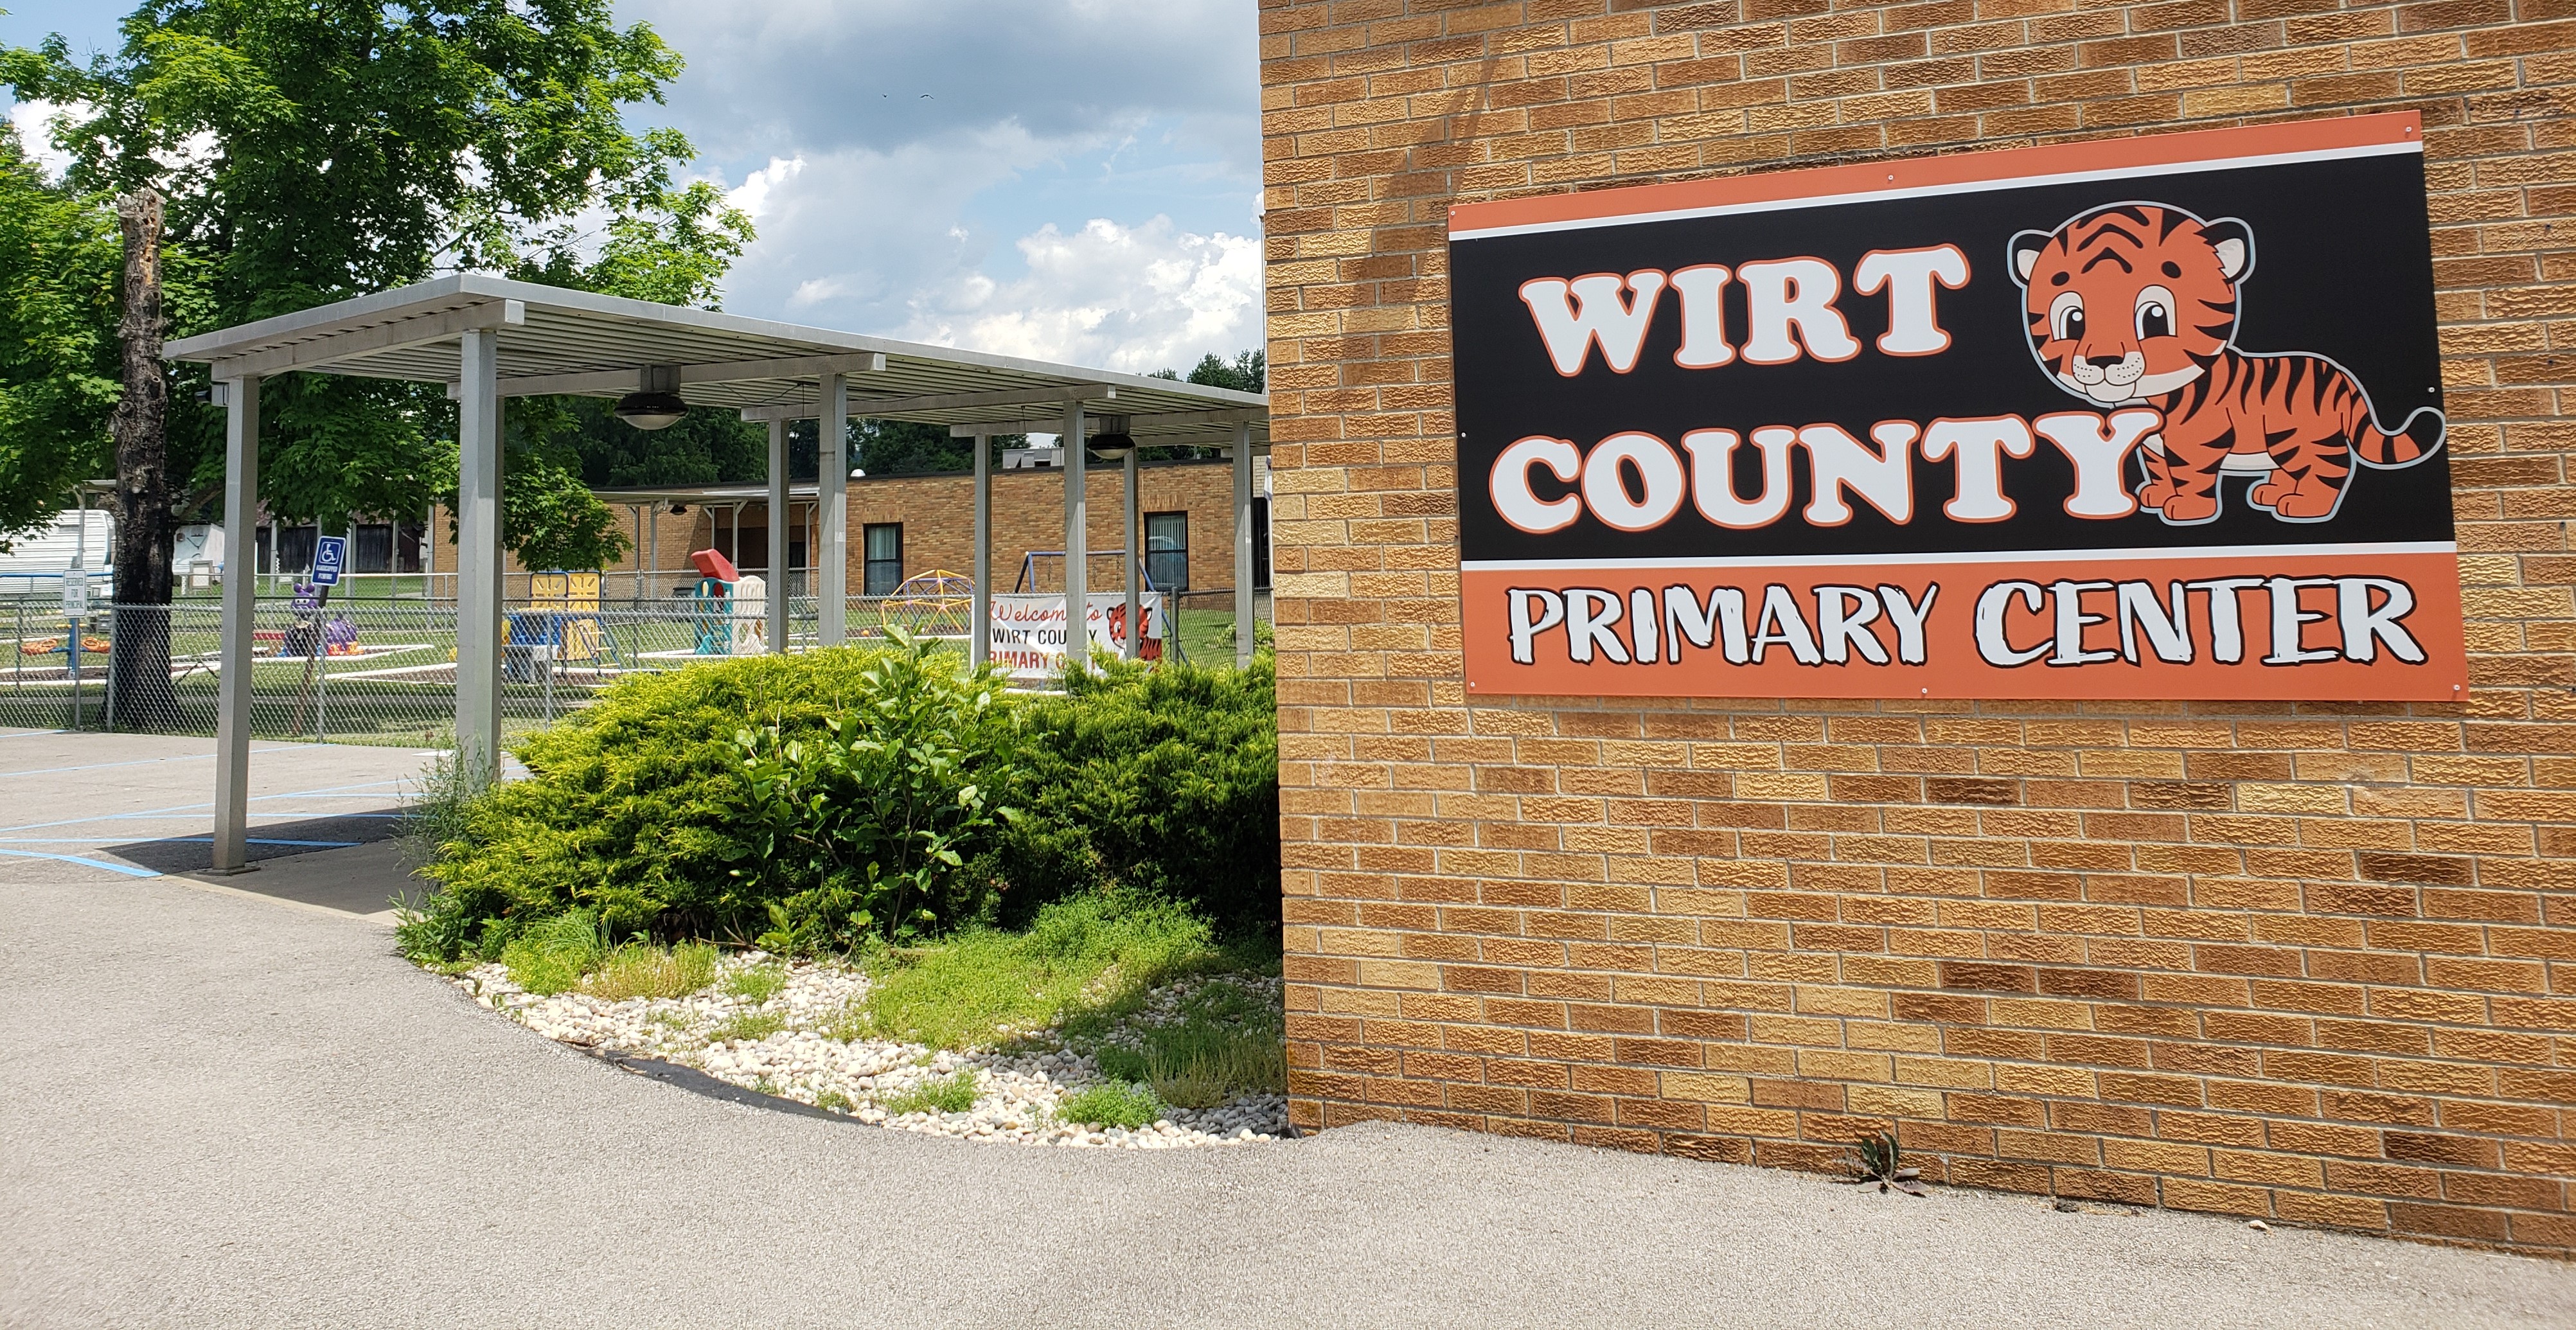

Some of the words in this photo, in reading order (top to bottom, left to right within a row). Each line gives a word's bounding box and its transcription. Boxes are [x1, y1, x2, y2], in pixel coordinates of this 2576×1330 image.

[1518, 243, 1971, 377] WIRT
[1489, 407, 2166, 534] COUNTY
[990, 601, 1067, 622] Welcom
[992, 628, 1031, 644] WIRT
[1037, 629, 1097, 645] COUY
[1507, 581, 1939, 666] PRIMARY
[1973, 575, 2429, 667] CENTER
[990, 650, 1050, 669] RIMARY
